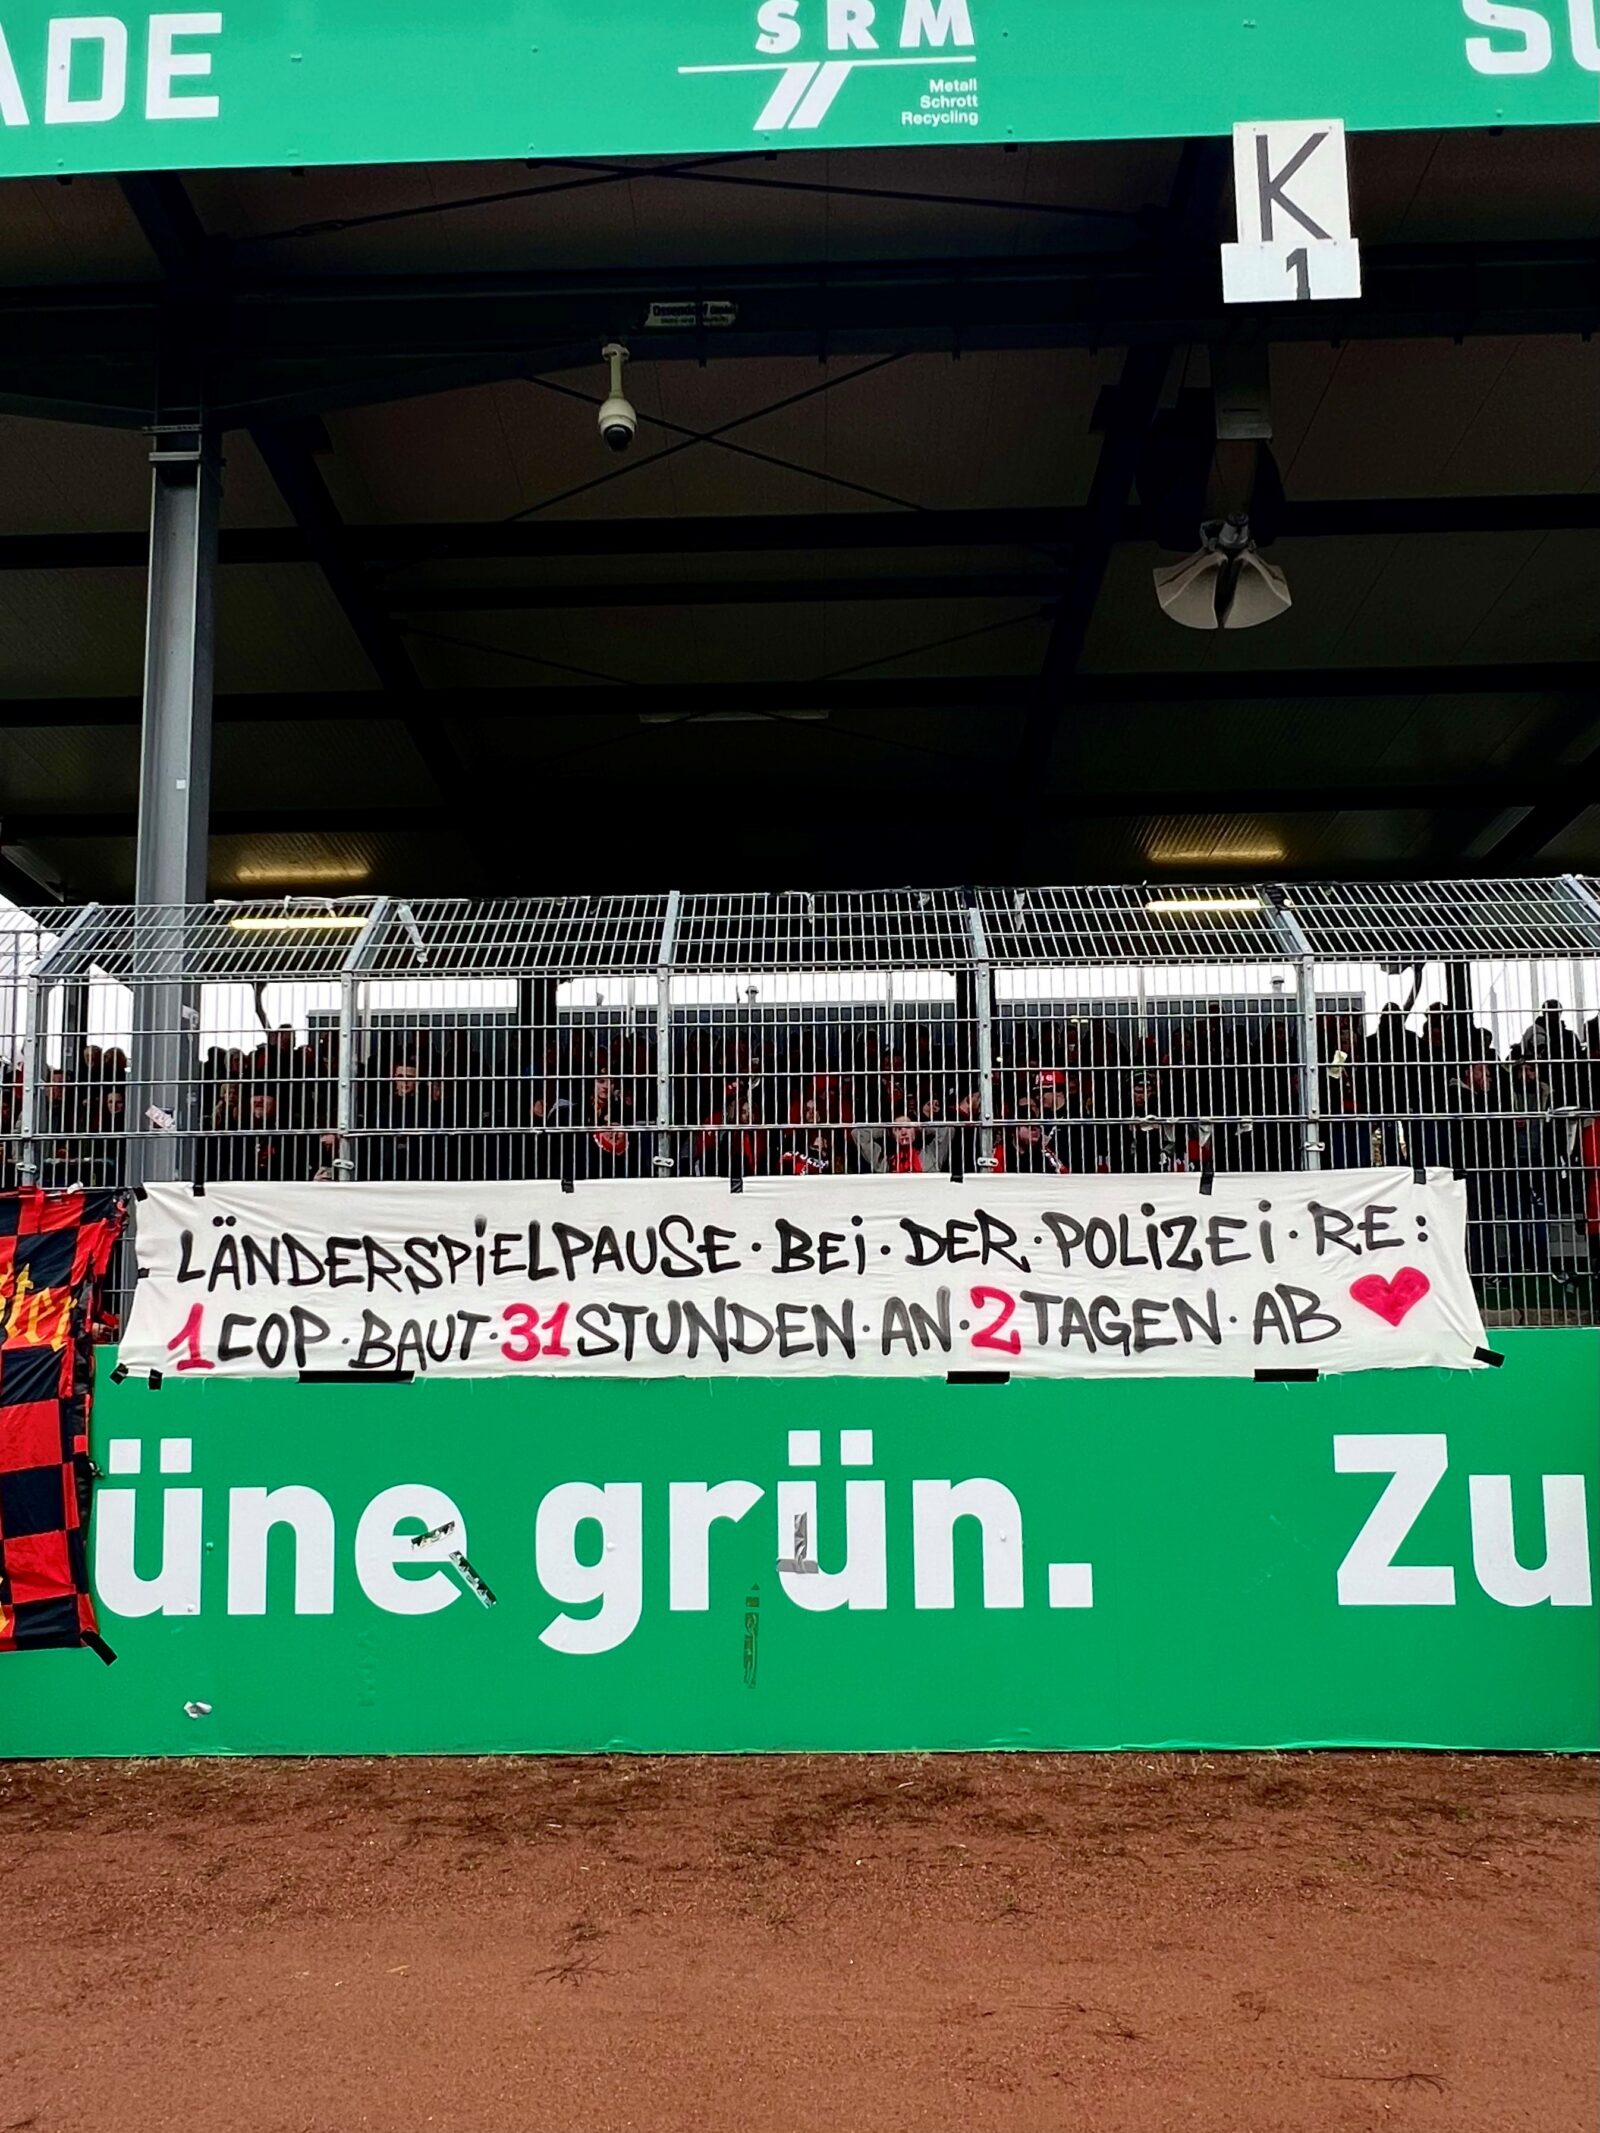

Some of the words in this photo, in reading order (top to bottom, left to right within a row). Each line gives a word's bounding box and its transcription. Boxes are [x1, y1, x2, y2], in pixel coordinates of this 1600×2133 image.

[755, 0, 975, 54] SRM
[919, 94, 978, 109] Schrott
[929, 78, 977, 93] Metall
[901, 110, 979, 126] Recycling
[1255, 132, 1333, 242] K
[1286, 247, 1311, 300] 1
[900, 1208, 1031, 1273] DER
[1307, 1201, 1429, 1256] RE:
[217, 1304, 331, 1369] COP
[348, 1308, 492, 1371] BAUT
[576, 1296, 856, 1362] STUNDEN
[881, 1285, 952, 1357] AN
[970, 1286, 1021, 1355] 2
[1019, 1288, 1222, 1357] TAGEN
[1253, 1283, 1342, 1346] AB
[535, 1429, 1093, 1654] grün.
[1333, 1433, 1593, 1607] Zu
